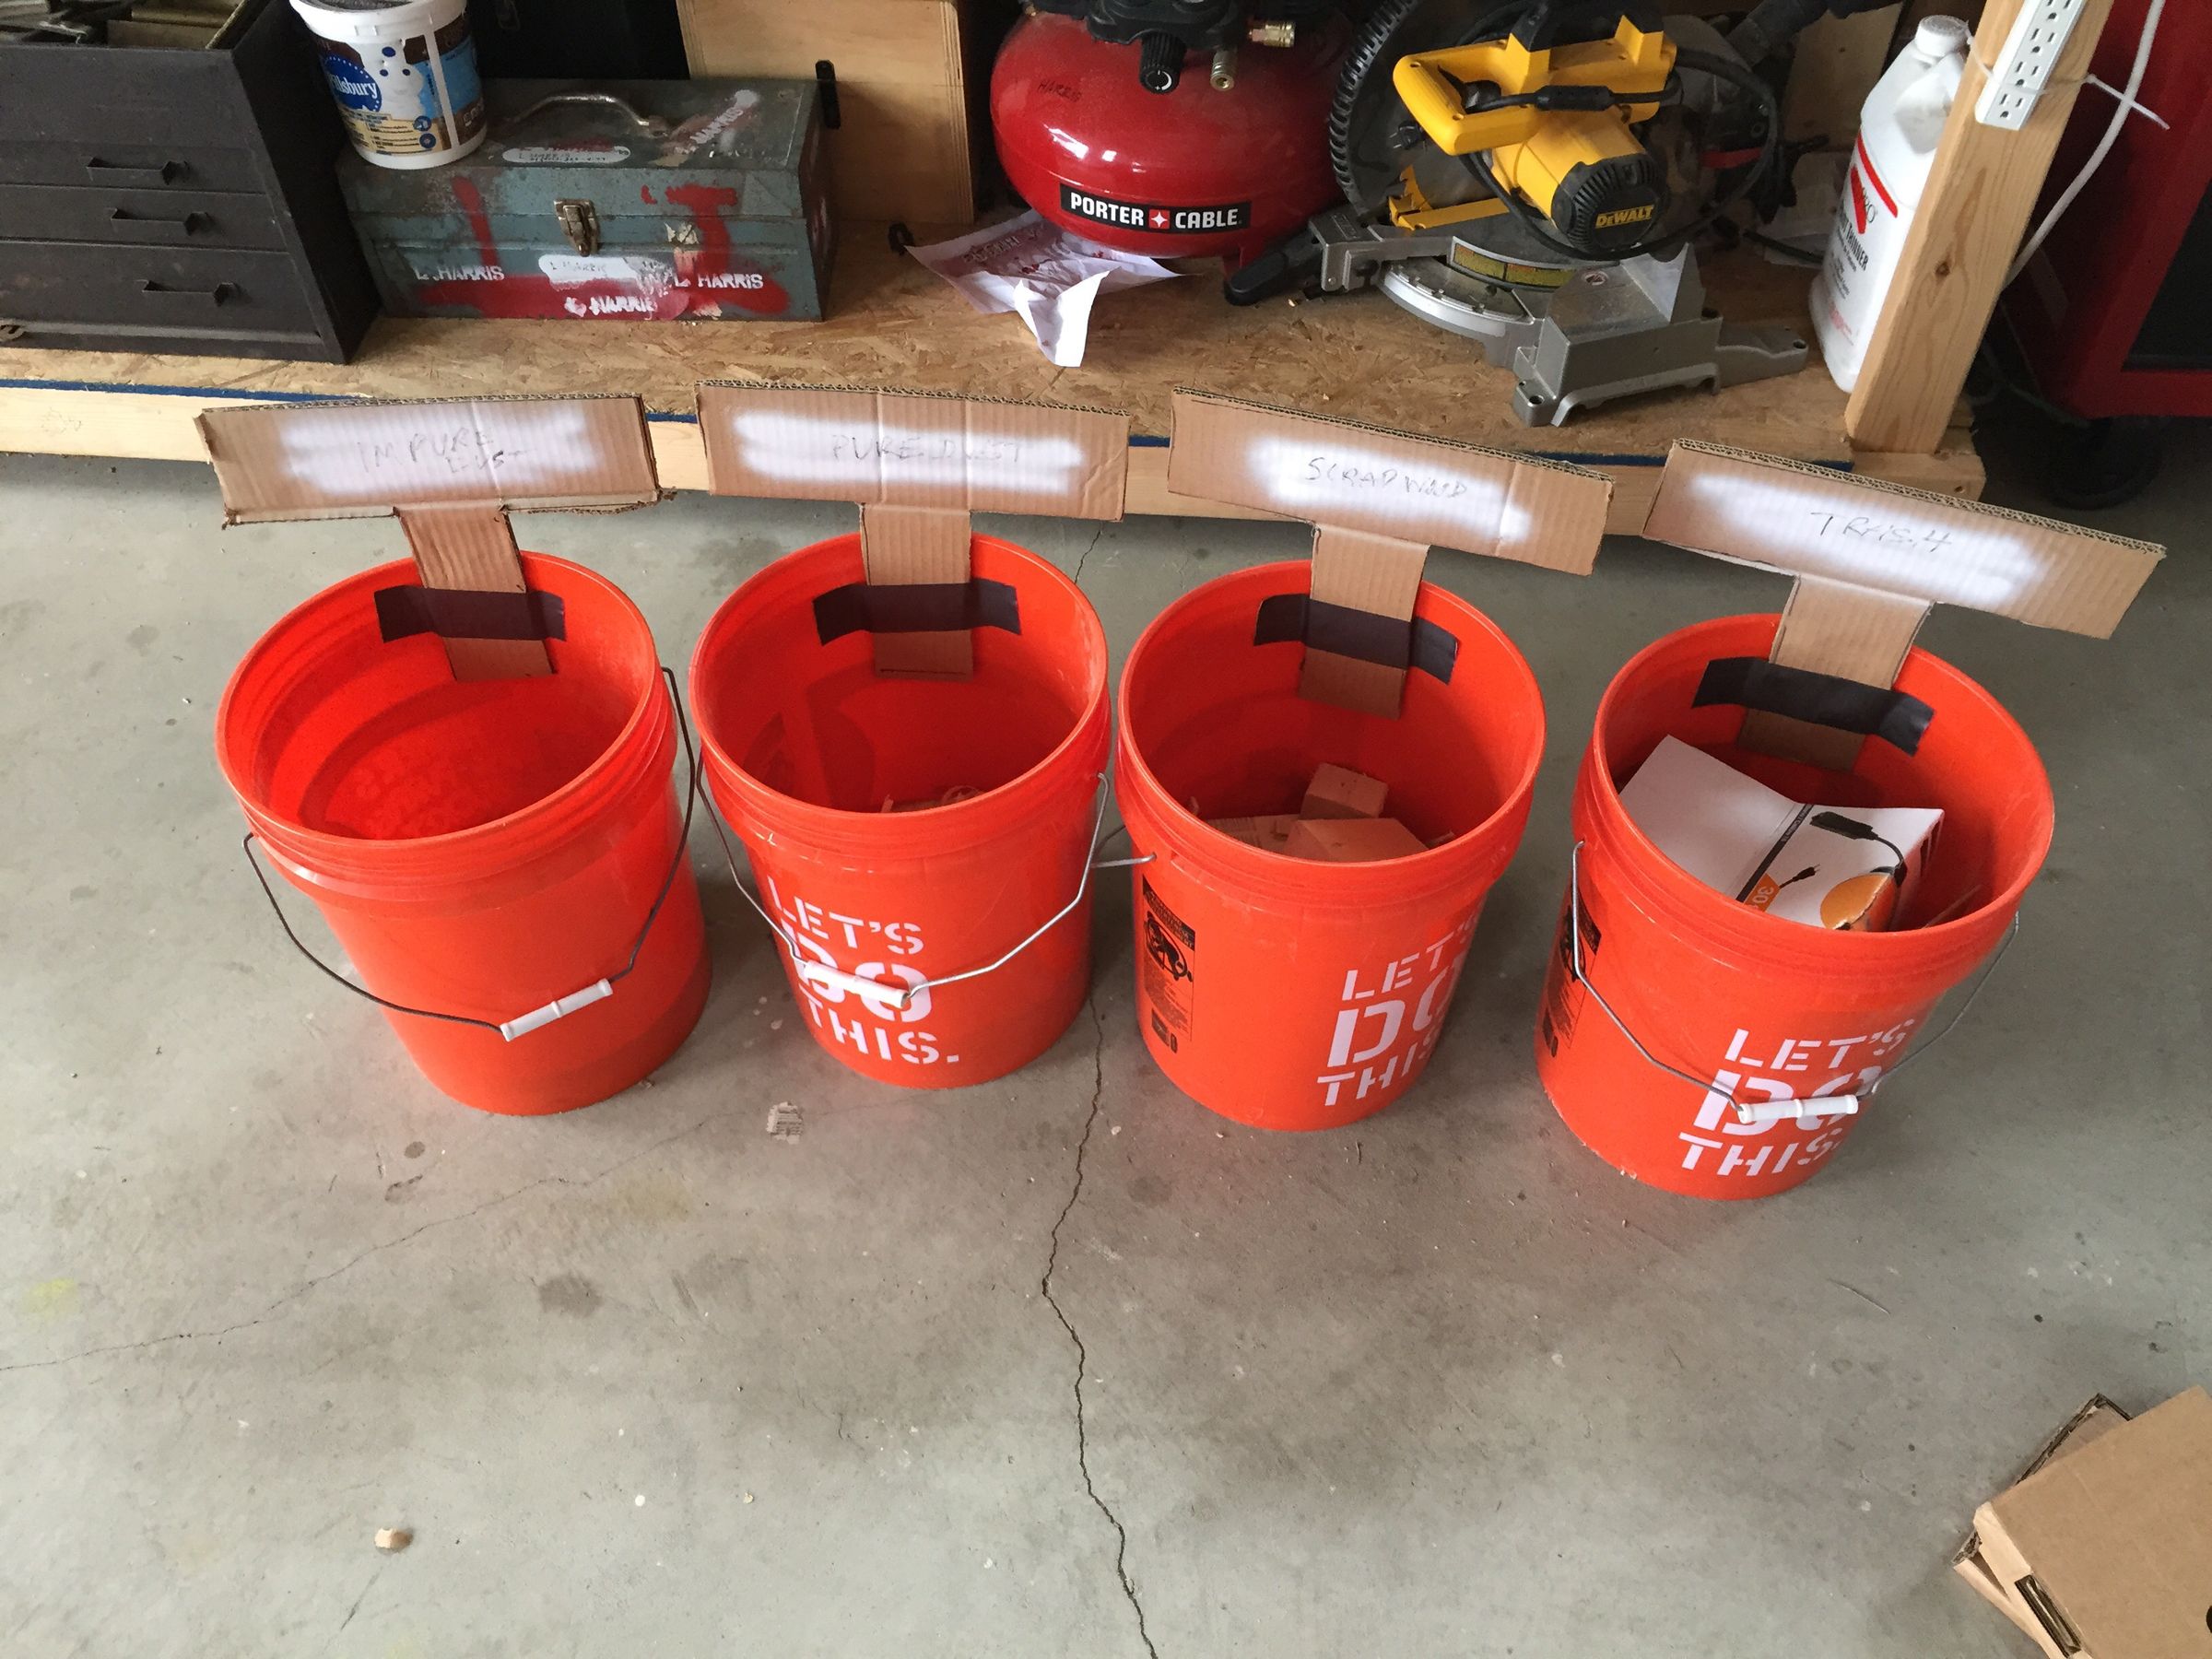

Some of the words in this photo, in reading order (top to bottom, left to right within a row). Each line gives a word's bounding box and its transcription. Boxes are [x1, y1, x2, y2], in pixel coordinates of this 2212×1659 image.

[1070, 191, 1145, 227] PORTER
[1175, 208, 1240, 229] CABLE
[433, 265, 505, 281] HARRIS
[698, 274, 764, 289] HARRIS
[768, 876, 924, 955] LET'S
[798, 983, 959, 1065] THIS.
[1724, 1018, 1915, 1071] LET'S
